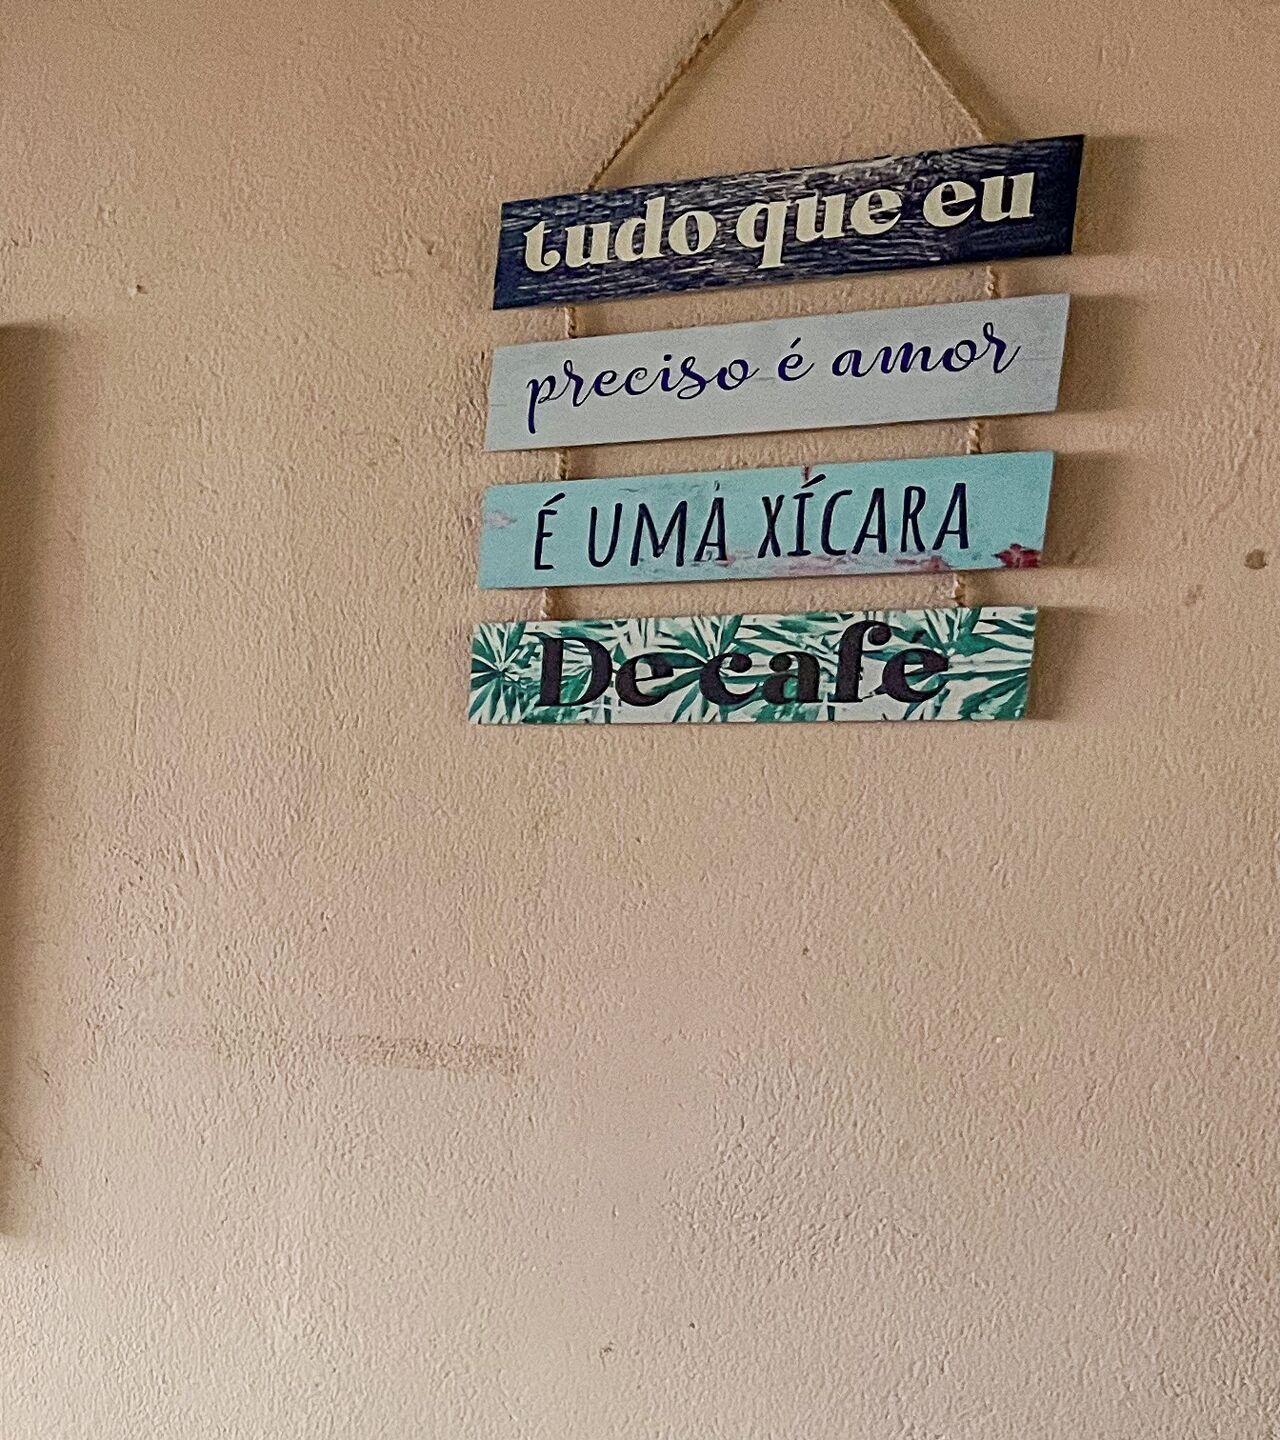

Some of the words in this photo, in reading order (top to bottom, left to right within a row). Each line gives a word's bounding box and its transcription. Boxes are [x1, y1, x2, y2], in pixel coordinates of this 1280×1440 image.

[523, 196, 717, 272] tudo
[736, 188, 902, 269] que
[923, 172, 1036, 228] eu
[527, 353, 758, 433] preciso
[778, 338, 814, 381] é
[832, 322, 1020, 377] amor
[534, 493, 566, 570] É
[588, 497, 727, 567] UMA
[758, 474, 969, 558] XÍCARA
[535, 637, 674, 707] De
